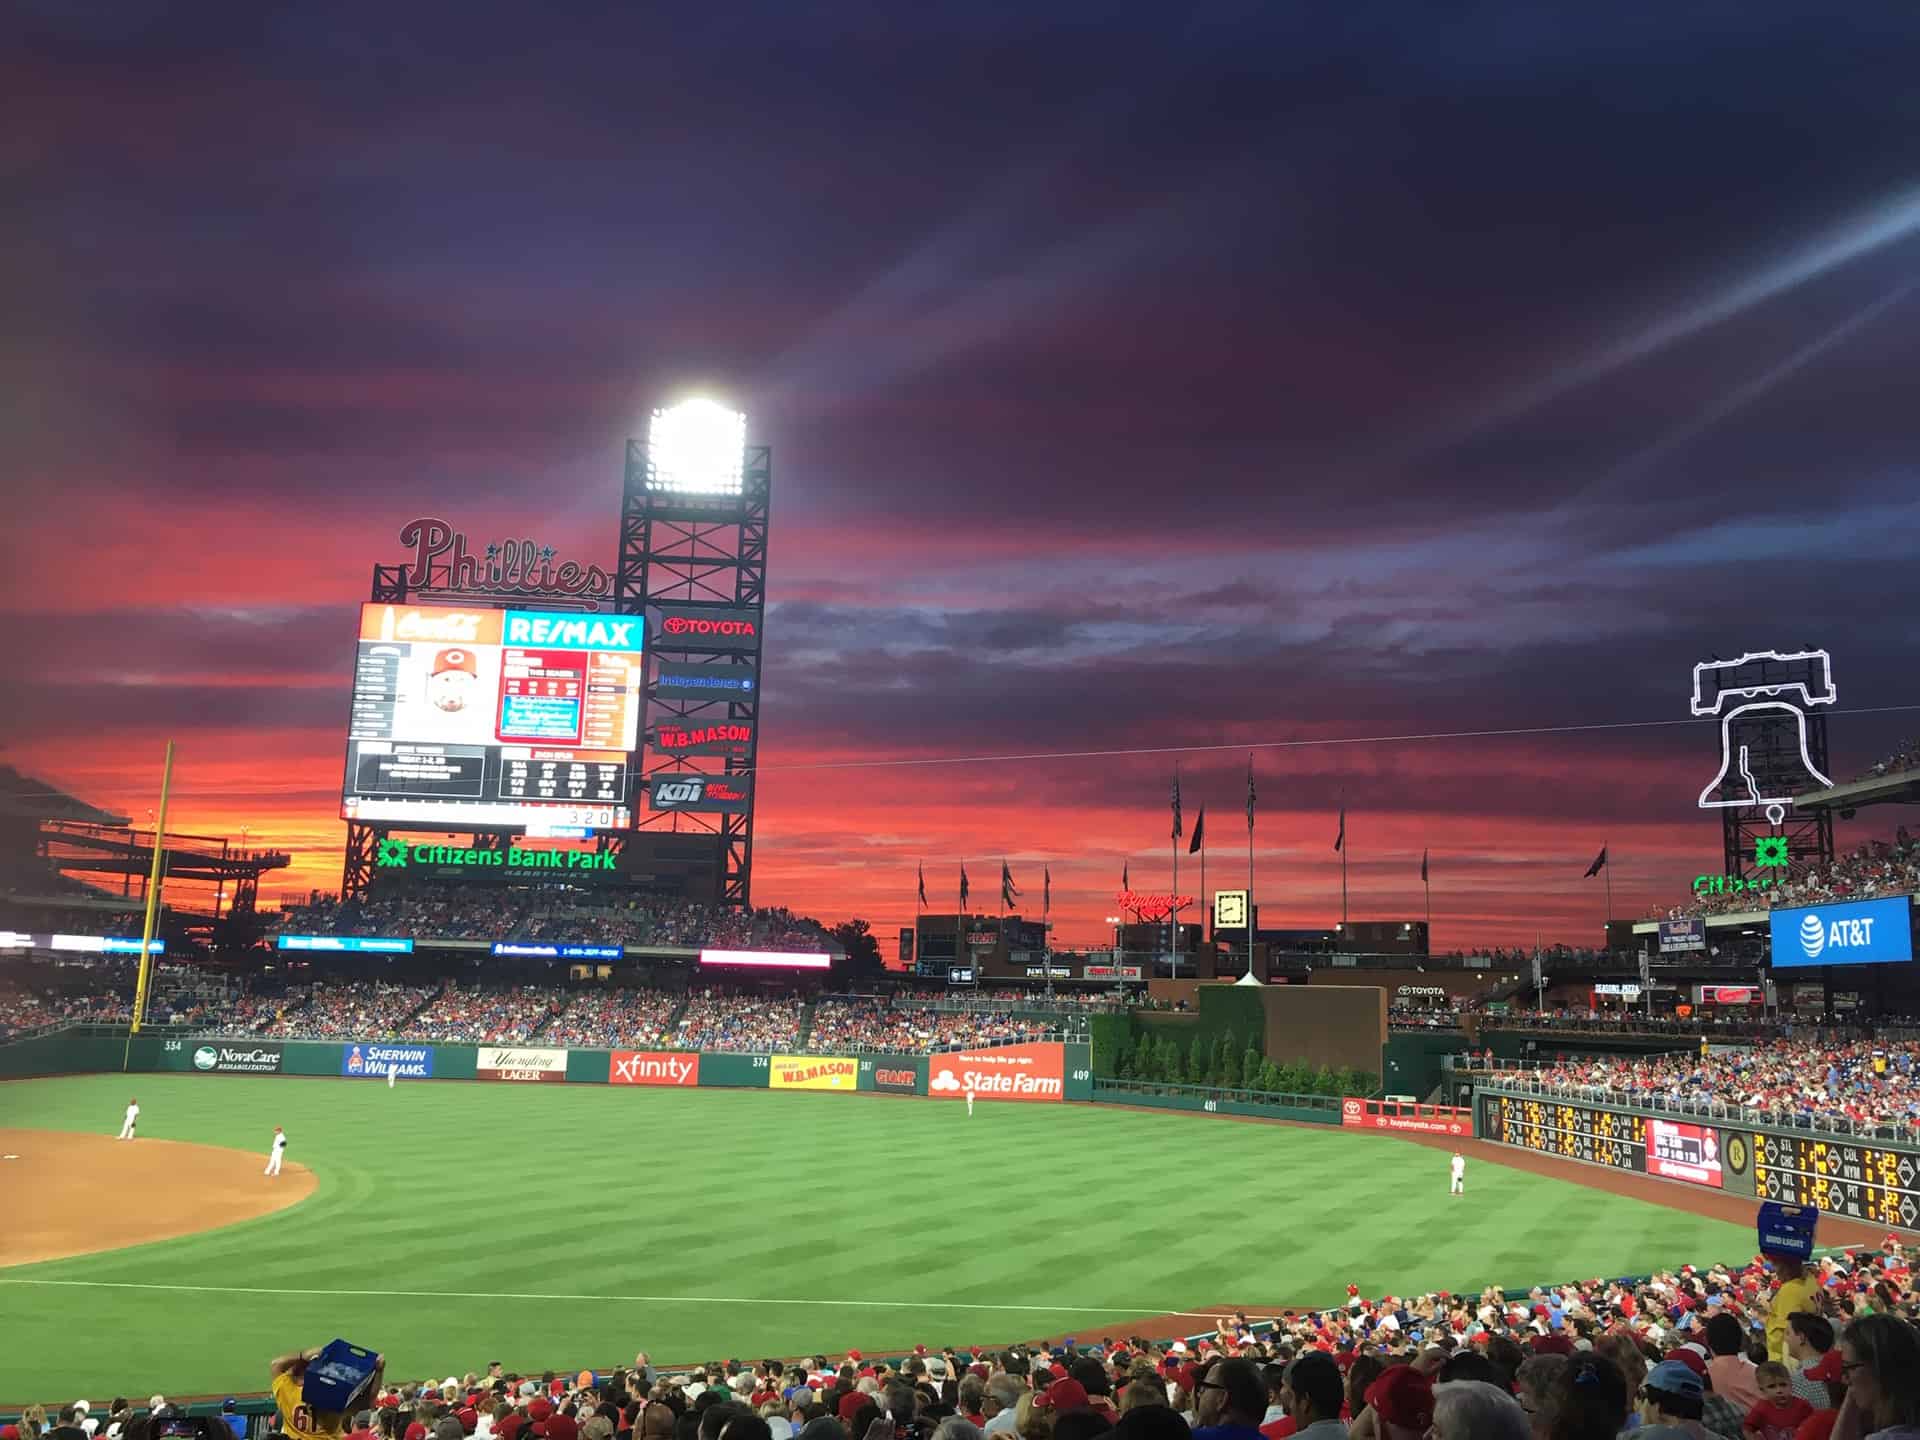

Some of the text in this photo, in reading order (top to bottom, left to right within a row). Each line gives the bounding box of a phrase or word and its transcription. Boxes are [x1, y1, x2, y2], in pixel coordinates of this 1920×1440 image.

[400, 517, 610, 597] Phillies
[510, 617, 634, 646] RE/MAX
[687, 620, 754, 635] TOYOTA
[661, 674, 738, 689] Independence
[585, 811, 593, 824] 2
[600, 812, 609, 825] 0
[413, 844, 616, 870] Citizens Bank Park
[1828, 918, 1874, 947] AT&T
[1411, 986, 1445, 995] TOYOTA
[218, 1048, 281, 1063] NovaCare
[367, 1047, 426, 1061] SHERWIN
[493, 1049, 553, 1068] Yuengling
[501, 1070, 541, 1080] LAGER
[615, 1054, 693, 1083] xfinity
[1072, 1070, 1089, 1081] 409
[875, 1069, 917, 1085] GIANT
[1204, 1100, 1217, 1112] 401
[1780, 1138, 1793, 1152] STL
[1843, 1147, 1859, 1162] COL
[1864, 1150, 1872, 1164] 2
[1782, 1172, 1795, 1187] ATL
[1847, 1184, 1859, 1199] PIT
[1782, 1237, 1805, 1249] LIGHT
